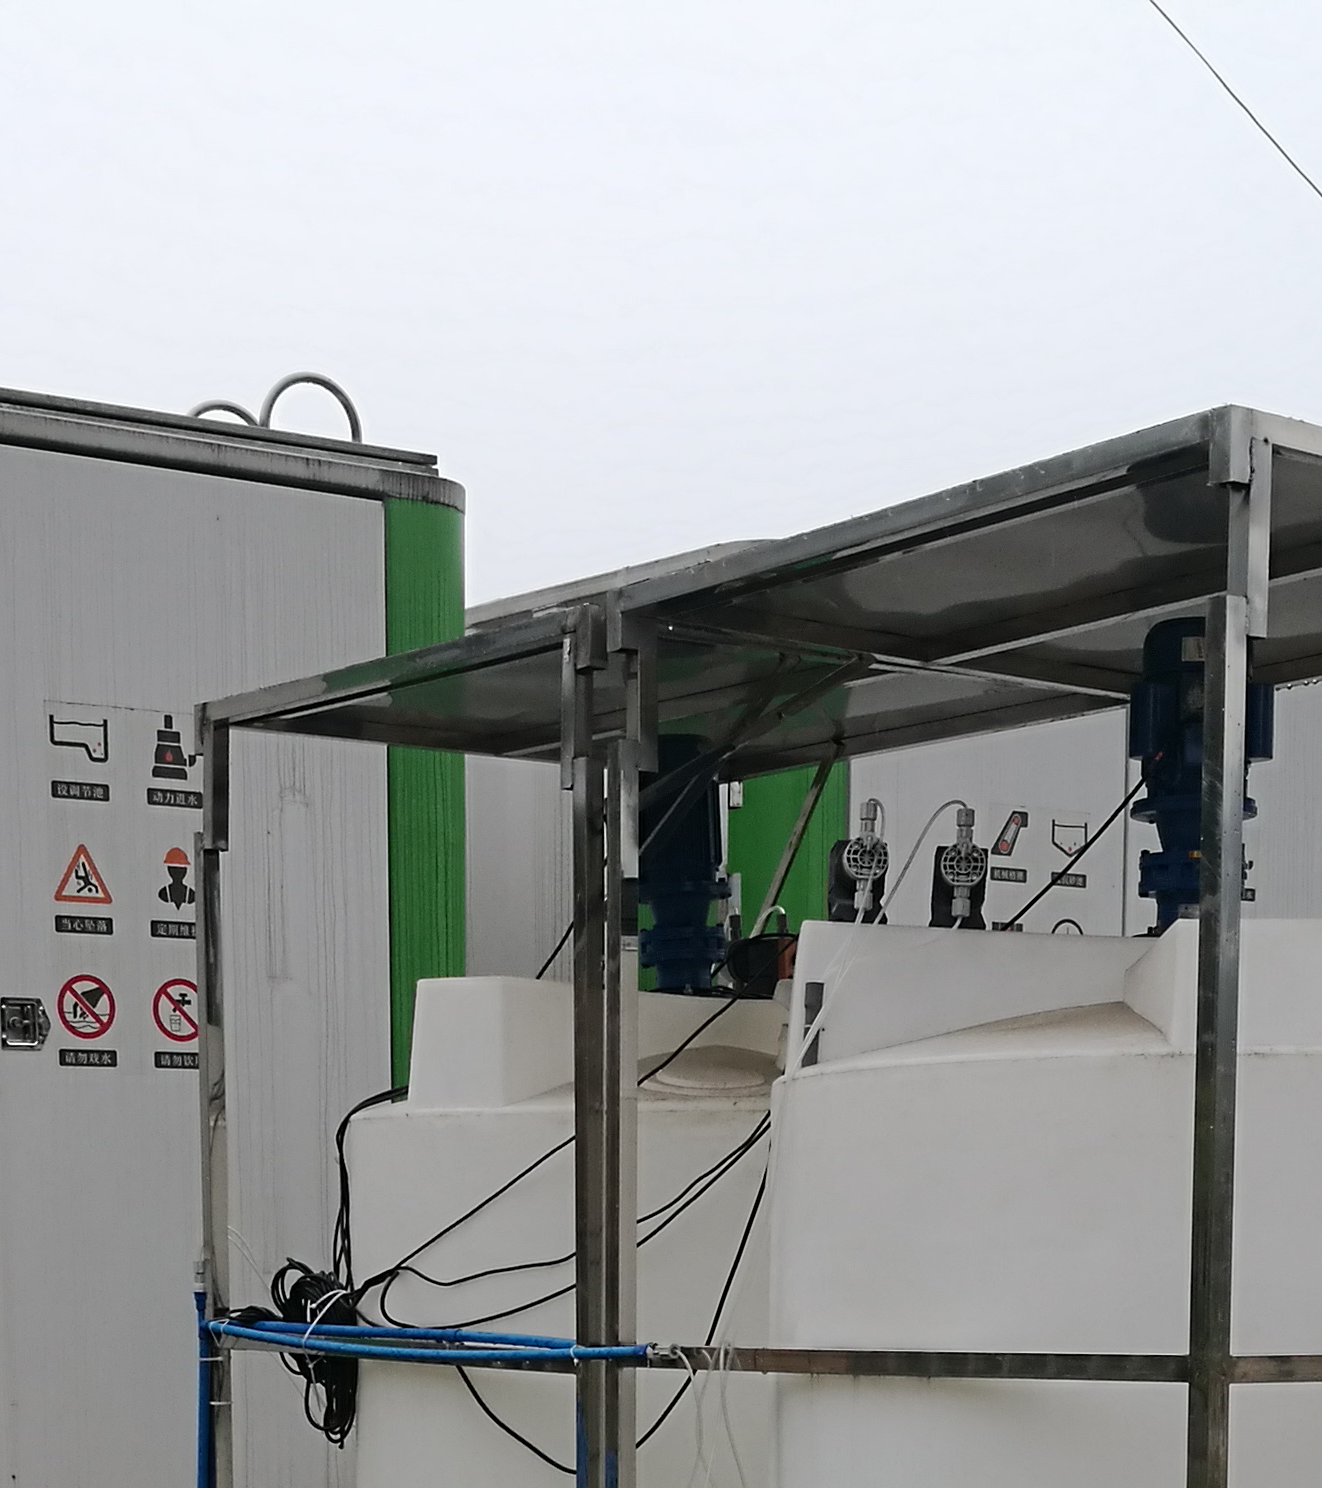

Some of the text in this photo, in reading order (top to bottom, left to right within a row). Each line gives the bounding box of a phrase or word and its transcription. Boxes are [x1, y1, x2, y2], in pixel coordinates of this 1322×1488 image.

[57, 783, 104, 799] 设调节池
[60, 917, 108, 932] 当心坠落
[64, 1051, 112, 1065] 请勿戏水
[160, 1053, 199, 1067] 请勿饮
